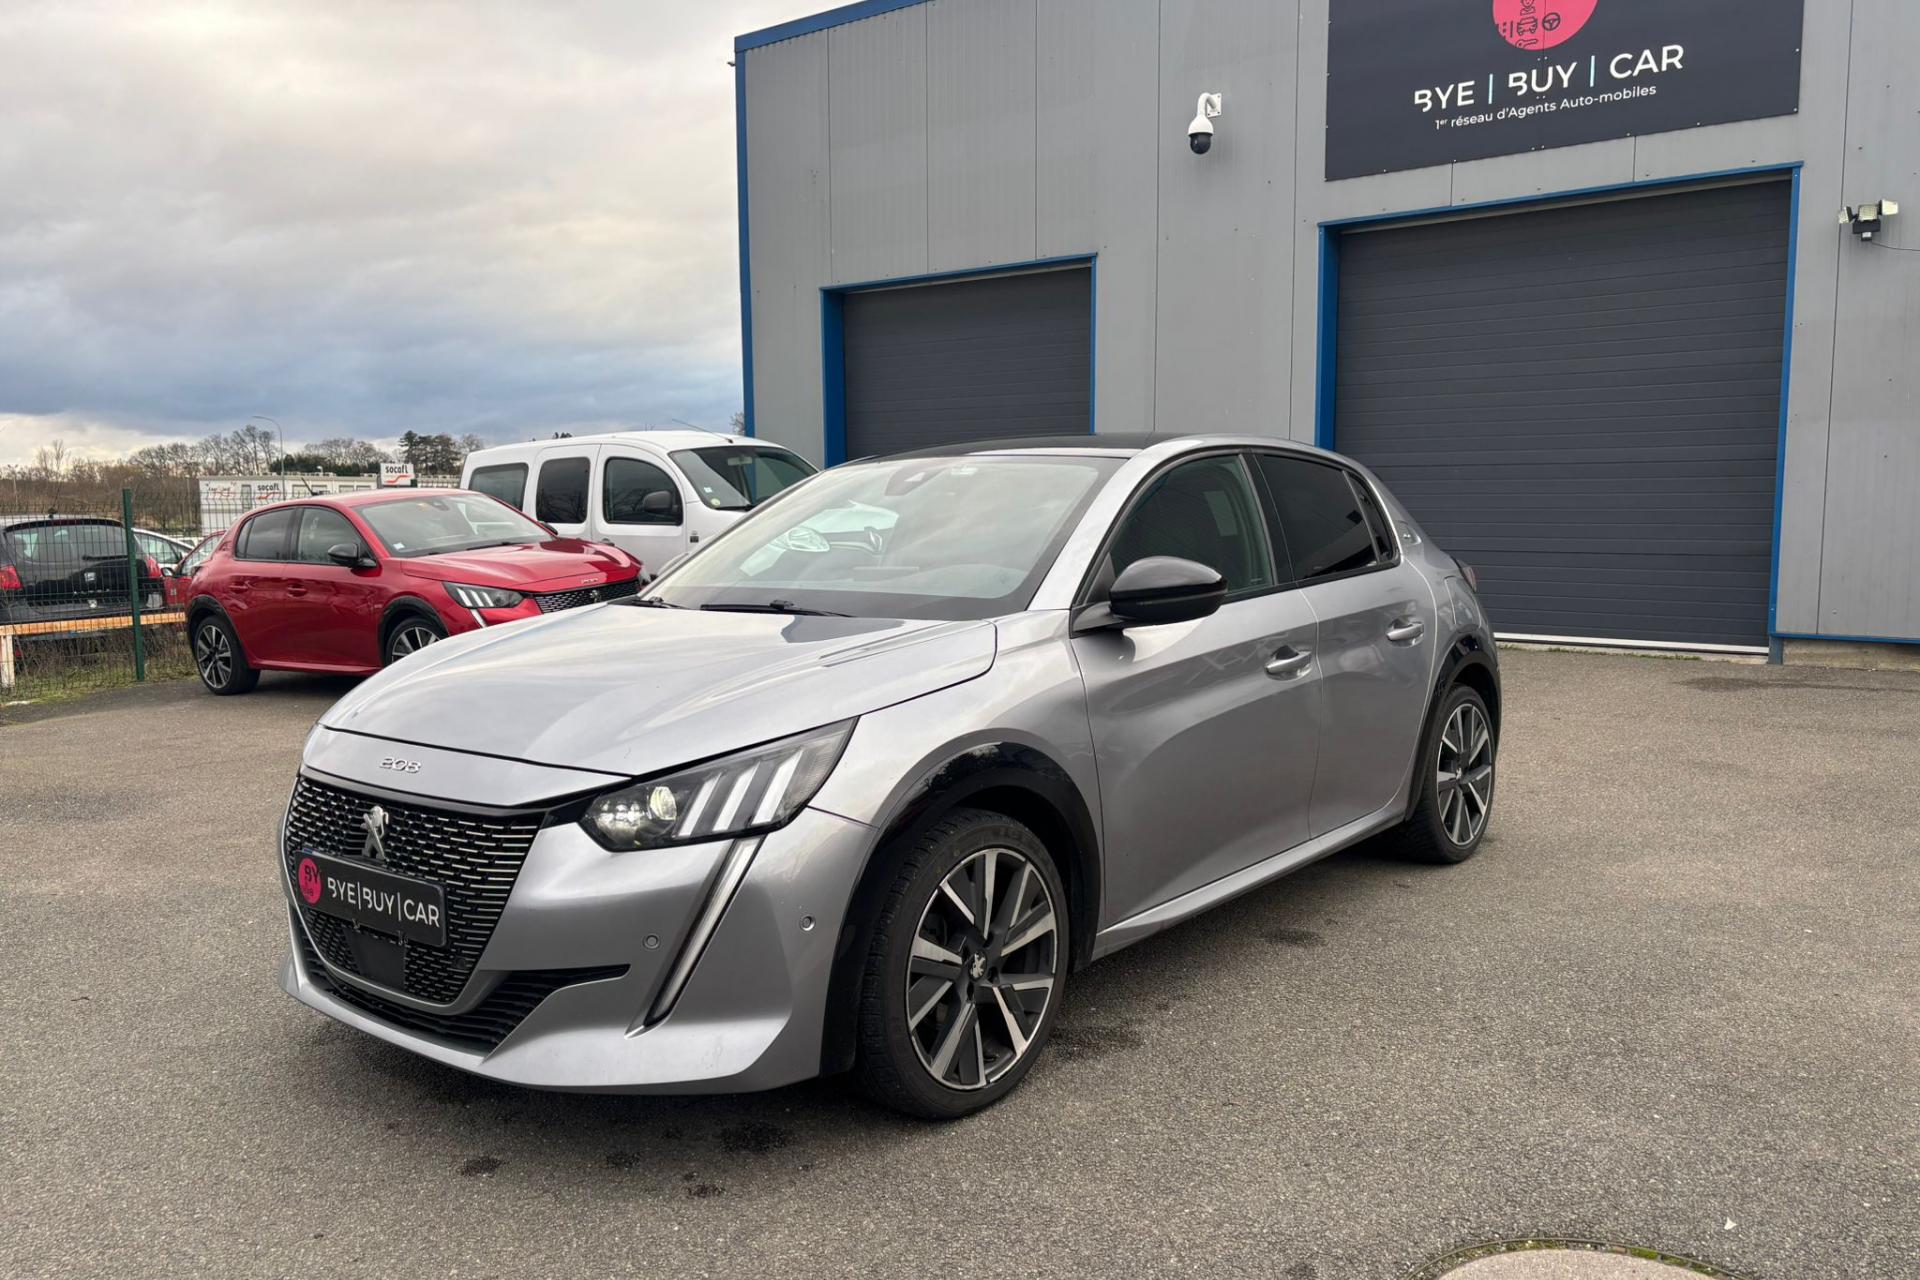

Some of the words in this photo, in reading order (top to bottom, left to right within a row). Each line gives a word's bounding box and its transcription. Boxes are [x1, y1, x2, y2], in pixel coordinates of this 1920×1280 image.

[1414, 80, 1475, 112] BYE
[1508, 62, 1577, 96] BUY
[1609, 44, 1685, 80] CAR
[1451, 111, 1494, 128] réseau
[1497, 101, 1556, 120] d'Agents
[1560, 84, 1657, 110] Auto-mobiles
[380, 757, 421, 774] 208
[327, 876, 357, 905] BYE
[362, 887, 395, 915] BUY
[403, 898, 440, 928] CAR
